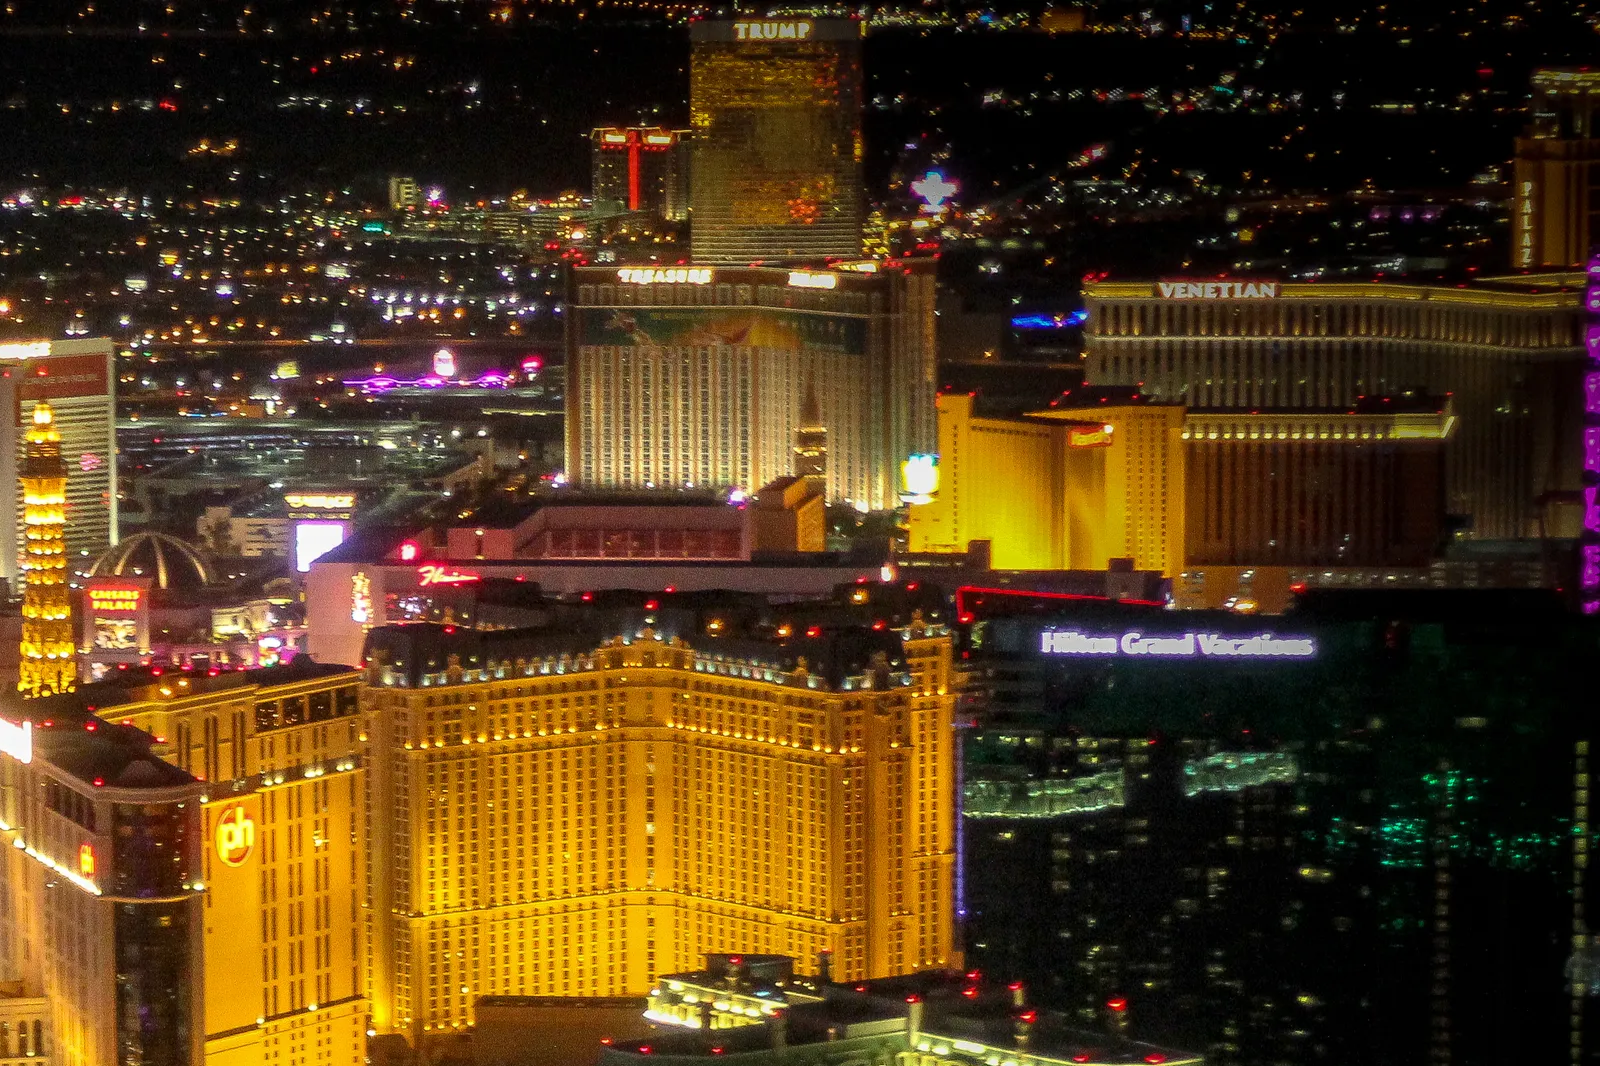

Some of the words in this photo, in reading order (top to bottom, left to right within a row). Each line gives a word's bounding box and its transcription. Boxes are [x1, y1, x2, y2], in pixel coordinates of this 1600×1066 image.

[734, 22, 811, 40] TRUMP
[1521, 180, 1533, 267] PALAZ
[617, 268, 713, 285] TREASURE
[1159, 281, 1276, 299] VENETIAN
[1041, 632, 1117, 653] Hilton
[1120, 632, 1195, 654] Grand
[1197, 634, 1314, 655] Vacations
